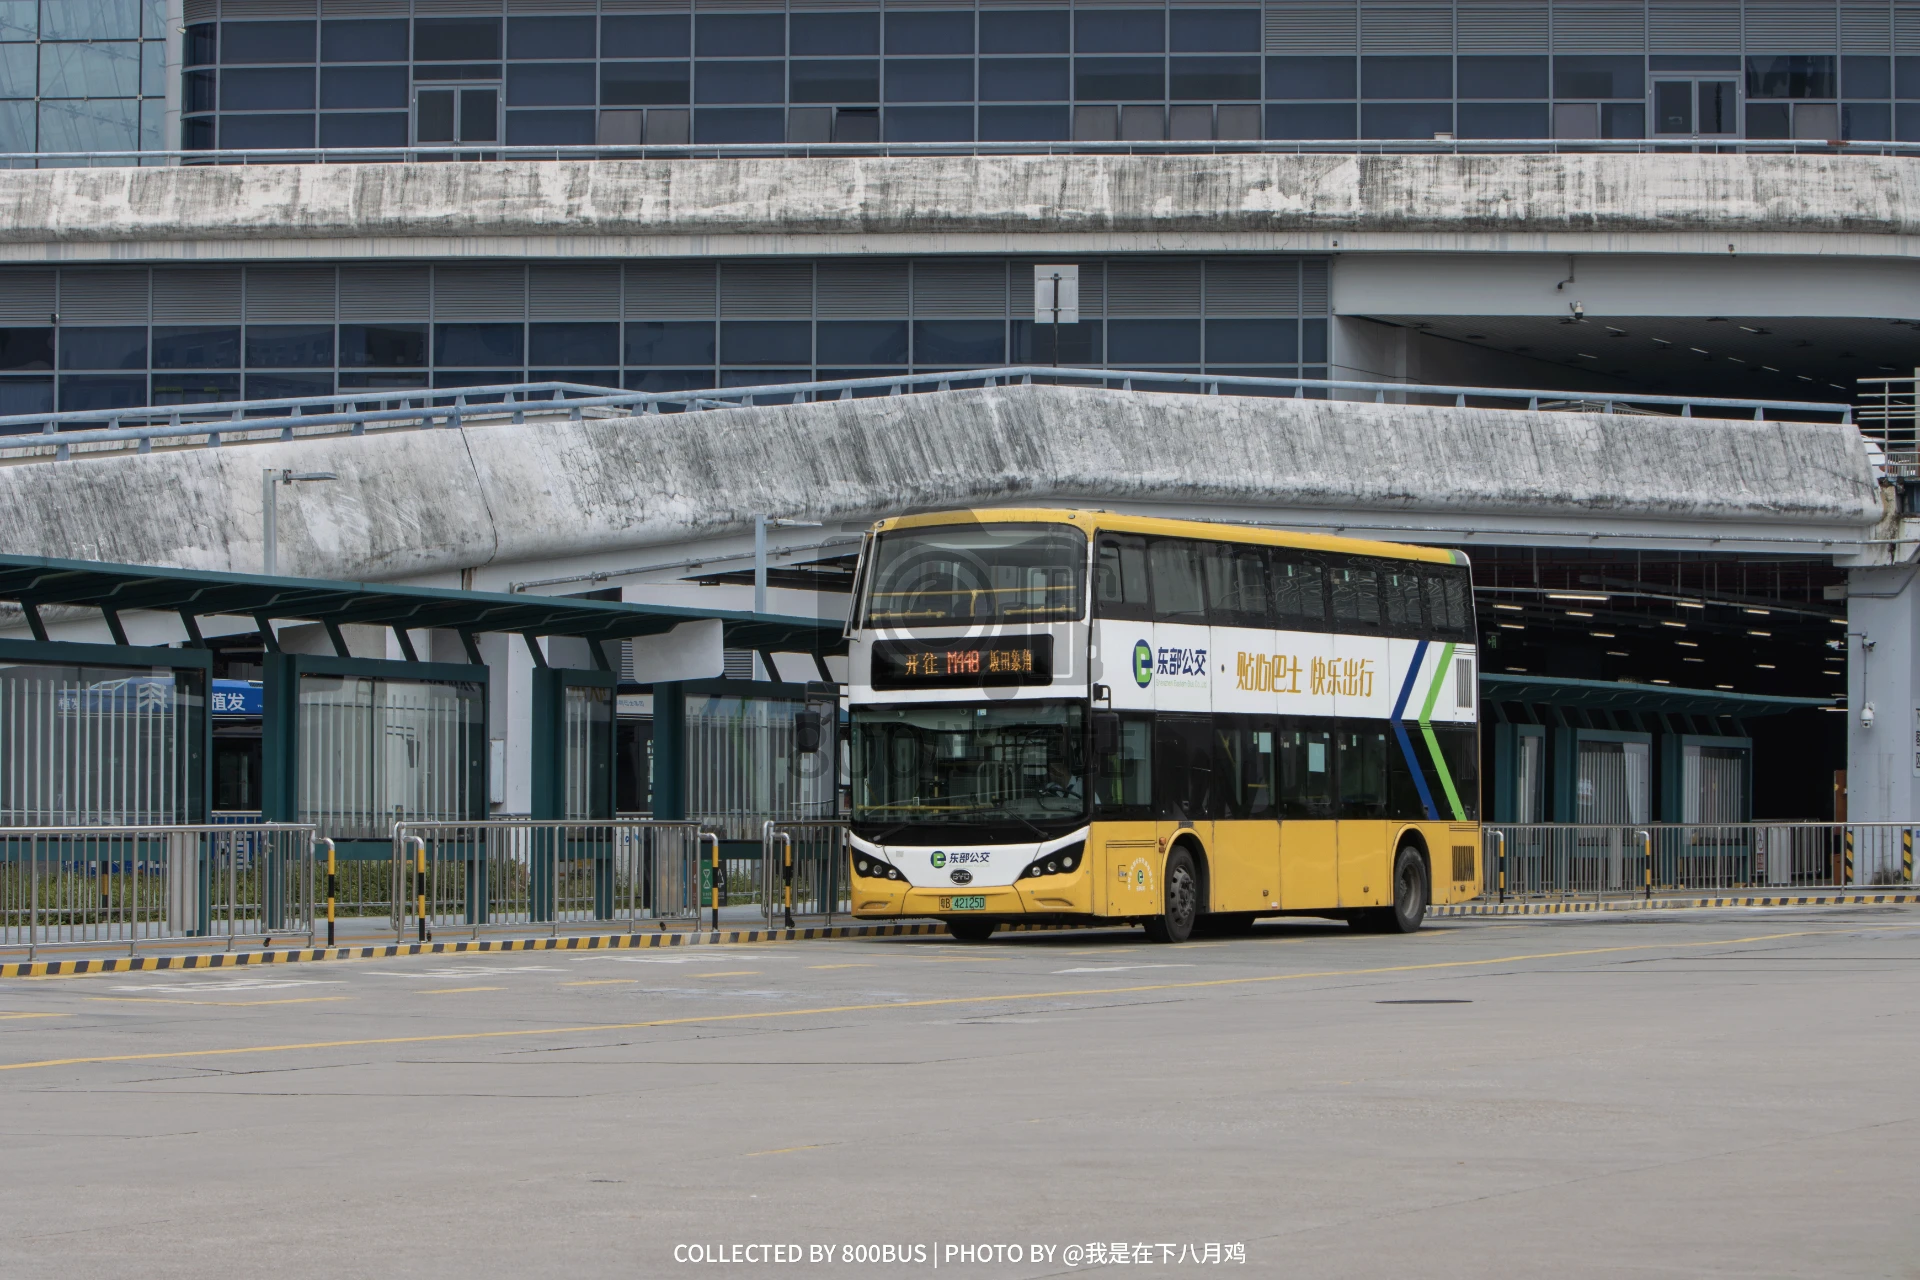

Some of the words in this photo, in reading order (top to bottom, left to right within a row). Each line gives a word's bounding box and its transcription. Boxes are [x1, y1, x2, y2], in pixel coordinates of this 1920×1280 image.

[905, 652, 939, 675] 开往
[947, 650, 980, 674] M448
[1156, 646, 1207, 676] 东部公交
[1236, 650, 1303, 694] 贴心巴士
[1309, 654, 1374, 698] 快乐出行
[212, 692, 246, 711] 植发
[949, 852, 991, 864] 东部公交
